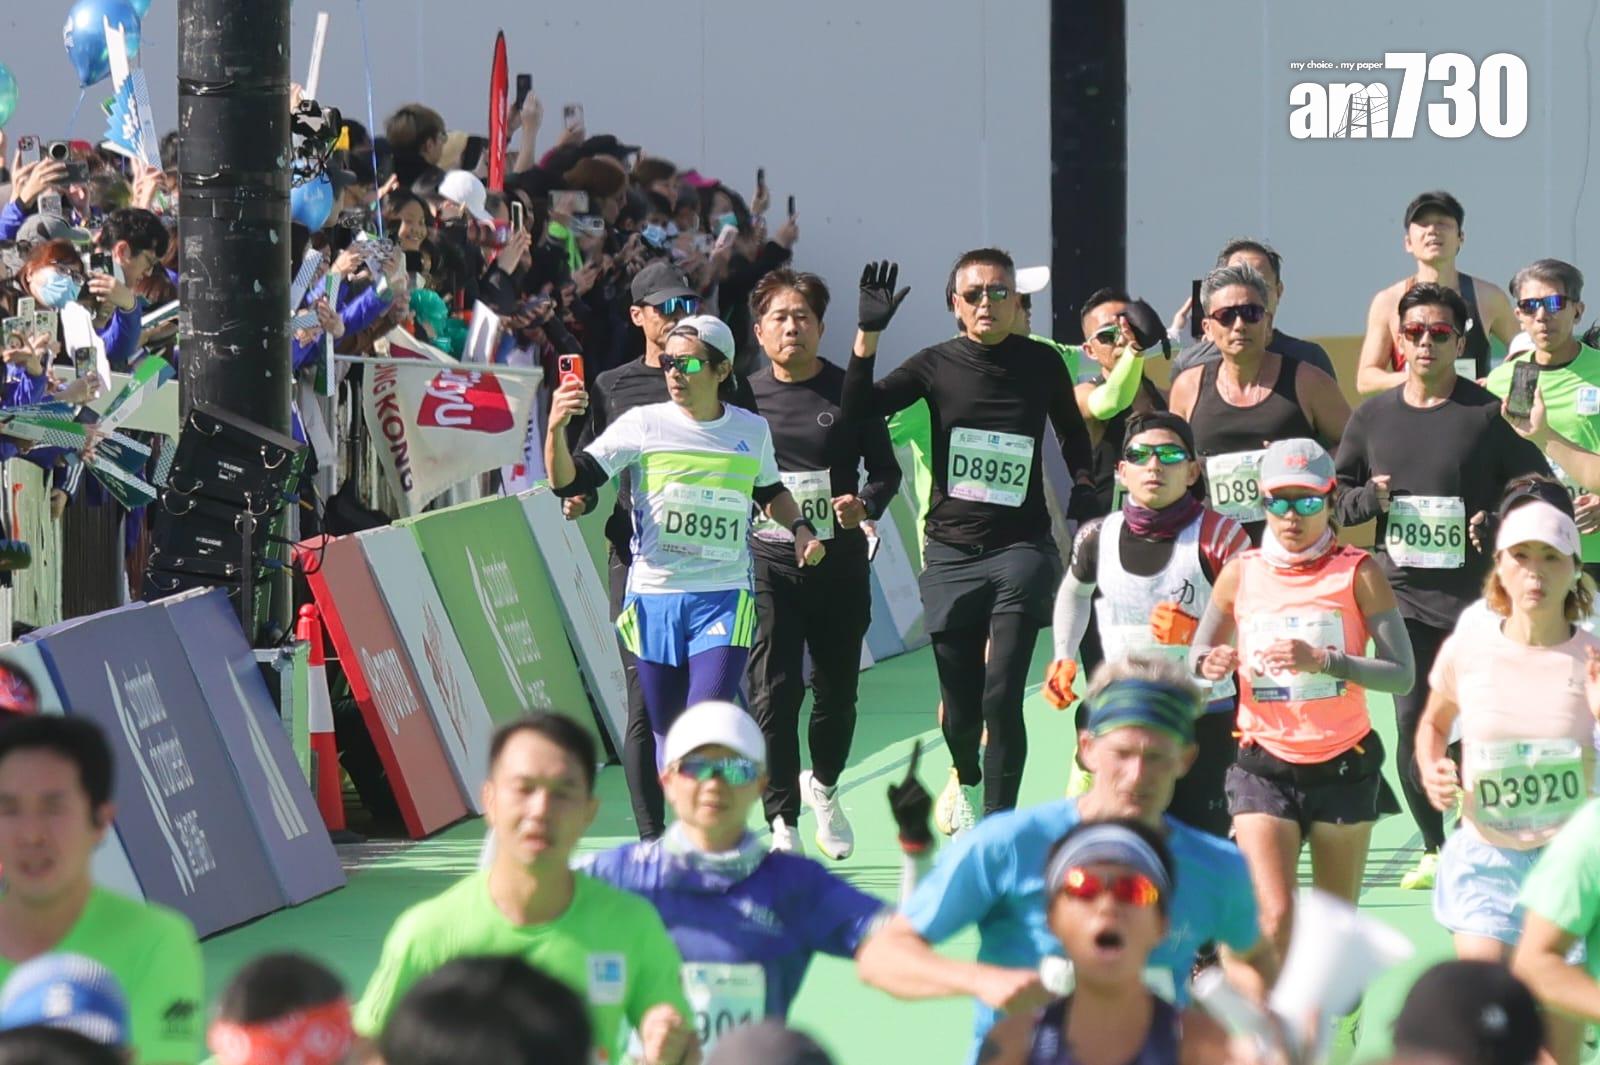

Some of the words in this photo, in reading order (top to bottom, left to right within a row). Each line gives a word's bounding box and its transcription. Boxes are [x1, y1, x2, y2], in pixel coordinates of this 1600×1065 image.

[374, 393, 413, 493] KONG
[953, 454, 1027, 487] D8952
[666, 510, 739, 542] D8951
[1390, 523, 1462, 547] D8956
[1479, 770, 1579, 808] D3920
